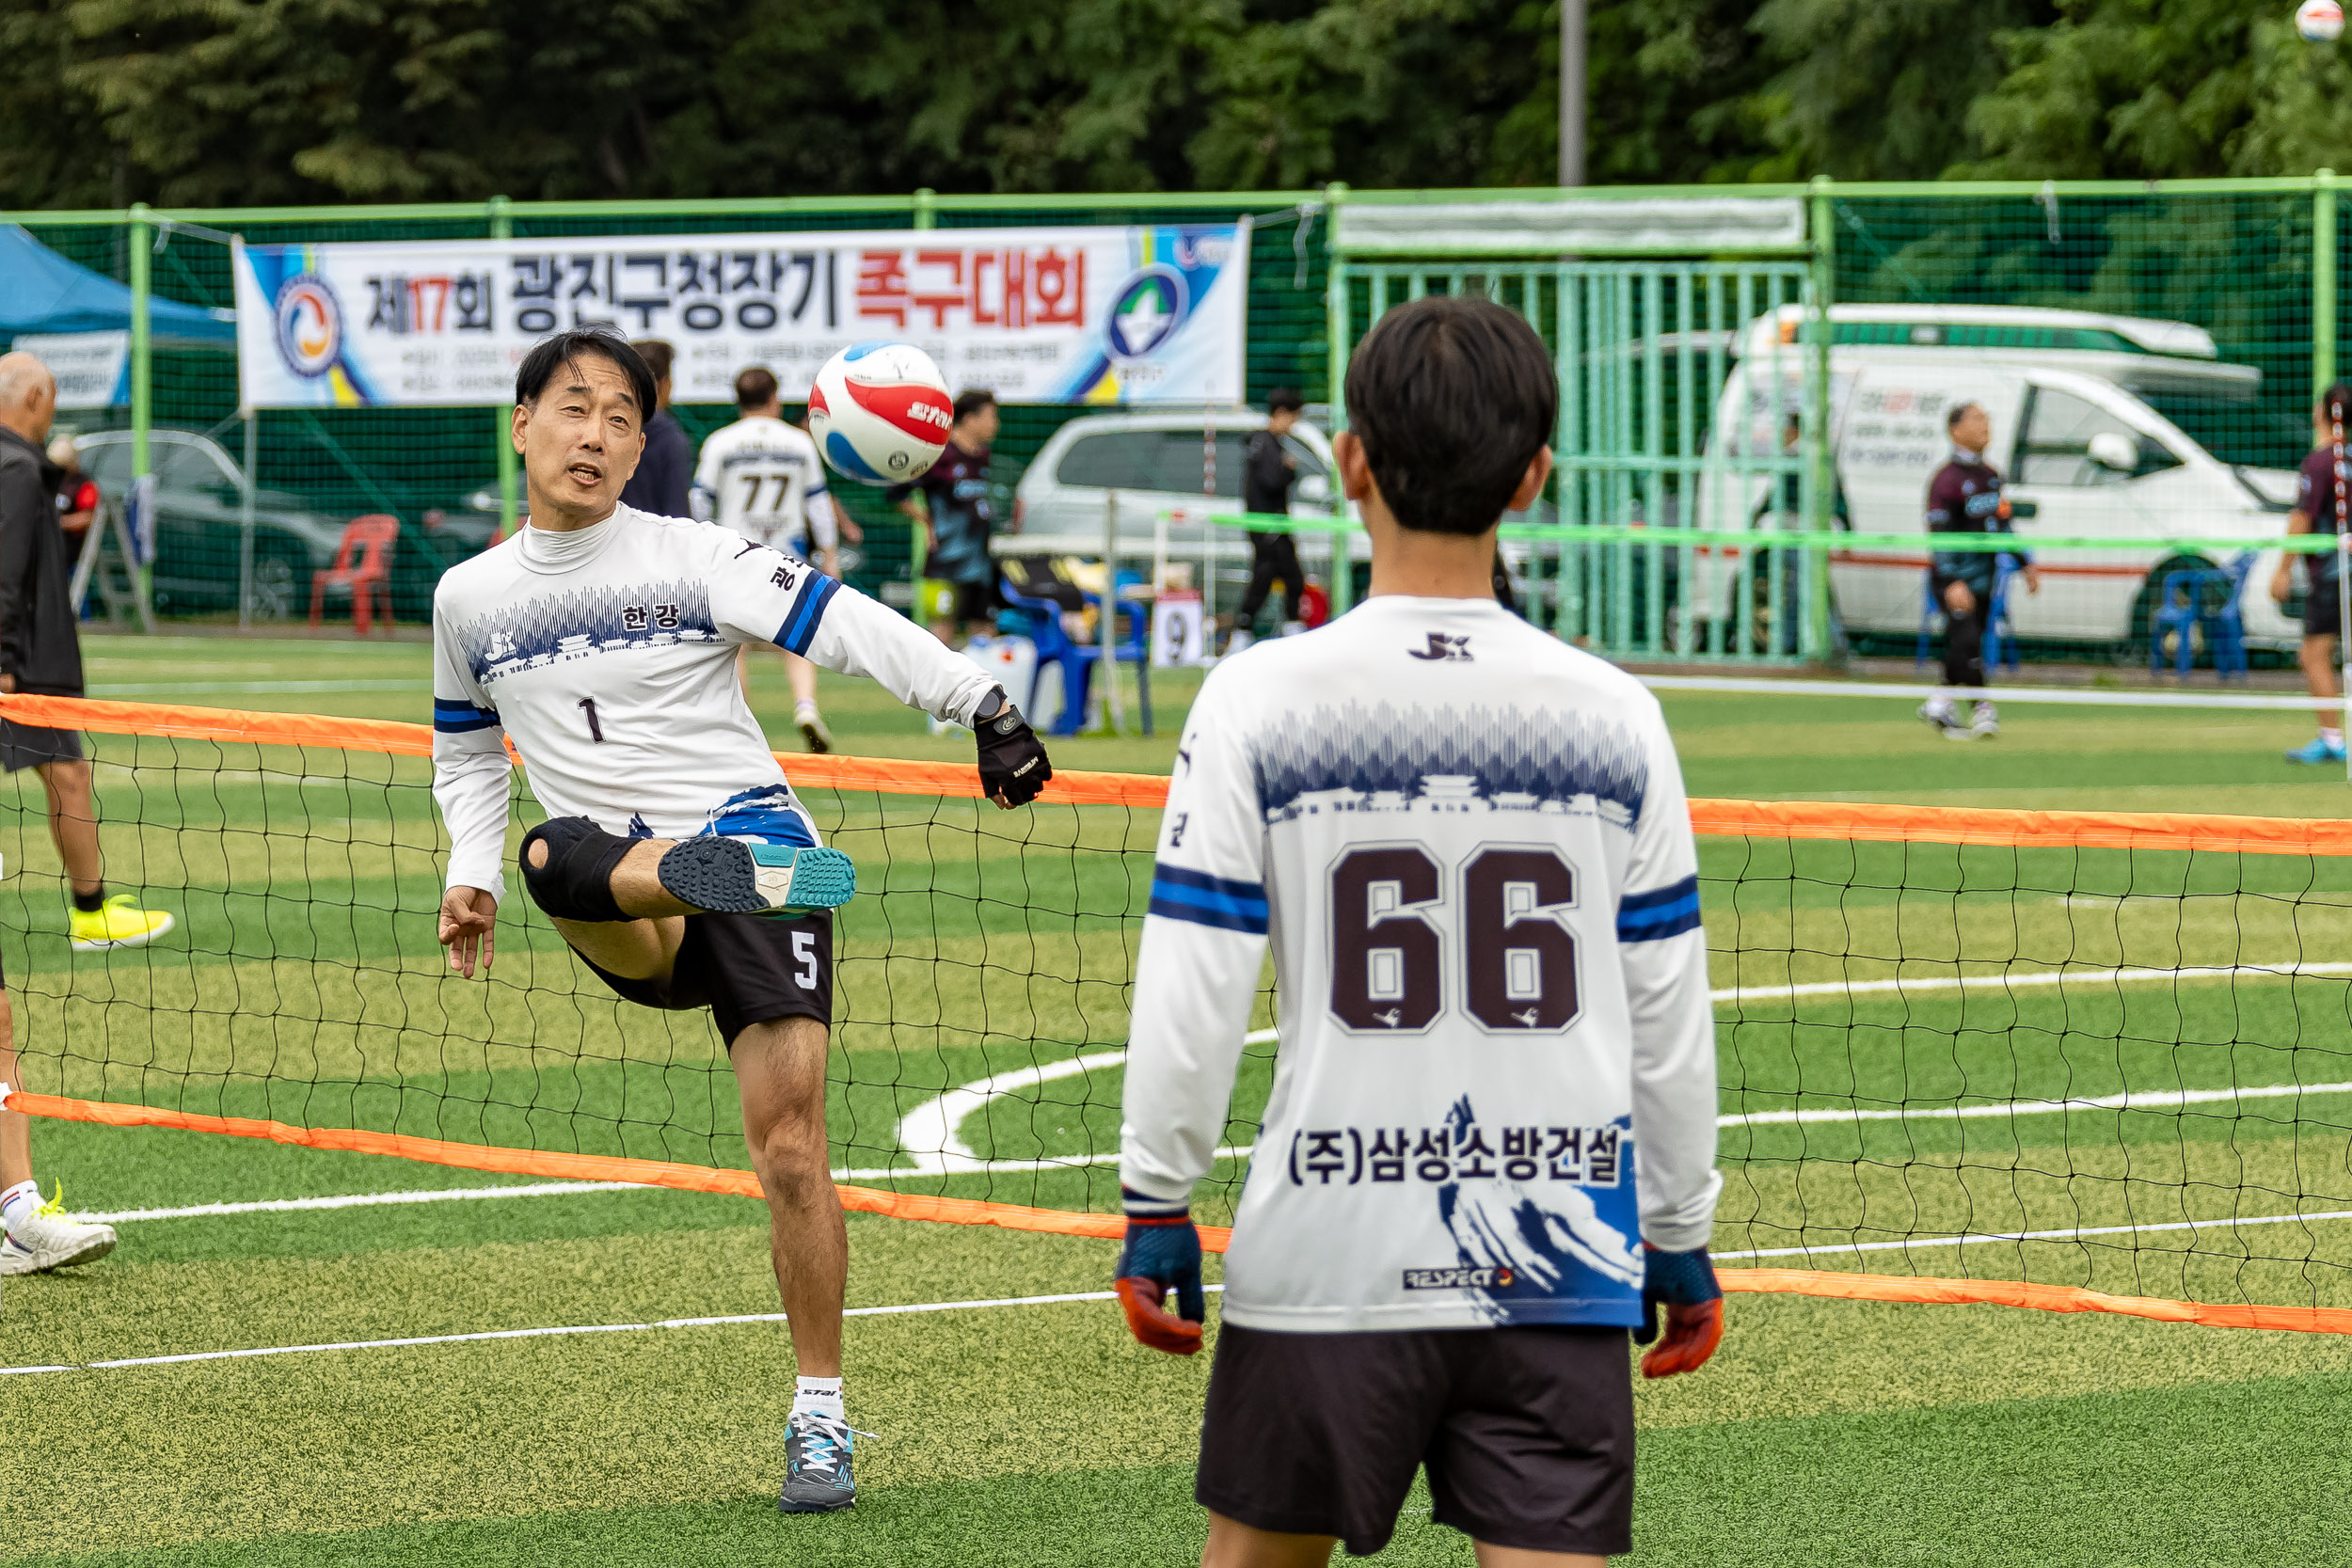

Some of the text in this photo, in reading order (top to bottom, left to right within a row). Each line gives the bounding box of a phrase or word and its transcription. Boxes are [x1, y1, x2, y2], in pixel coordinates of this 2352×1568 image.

[366, 246, 1087, 336] 제17회 광진구청장기 족구대회
[740, 473, 790, 513] 77
[576, 694, 607, 744] 1
[791, 931, 817, 990] 5
[1327, 842, 1582, 1033] 66
[1288, 1125, 1620, 1187] (주)삼성소방건설
[1406, 1269, 1494, 1289] RESPECT
